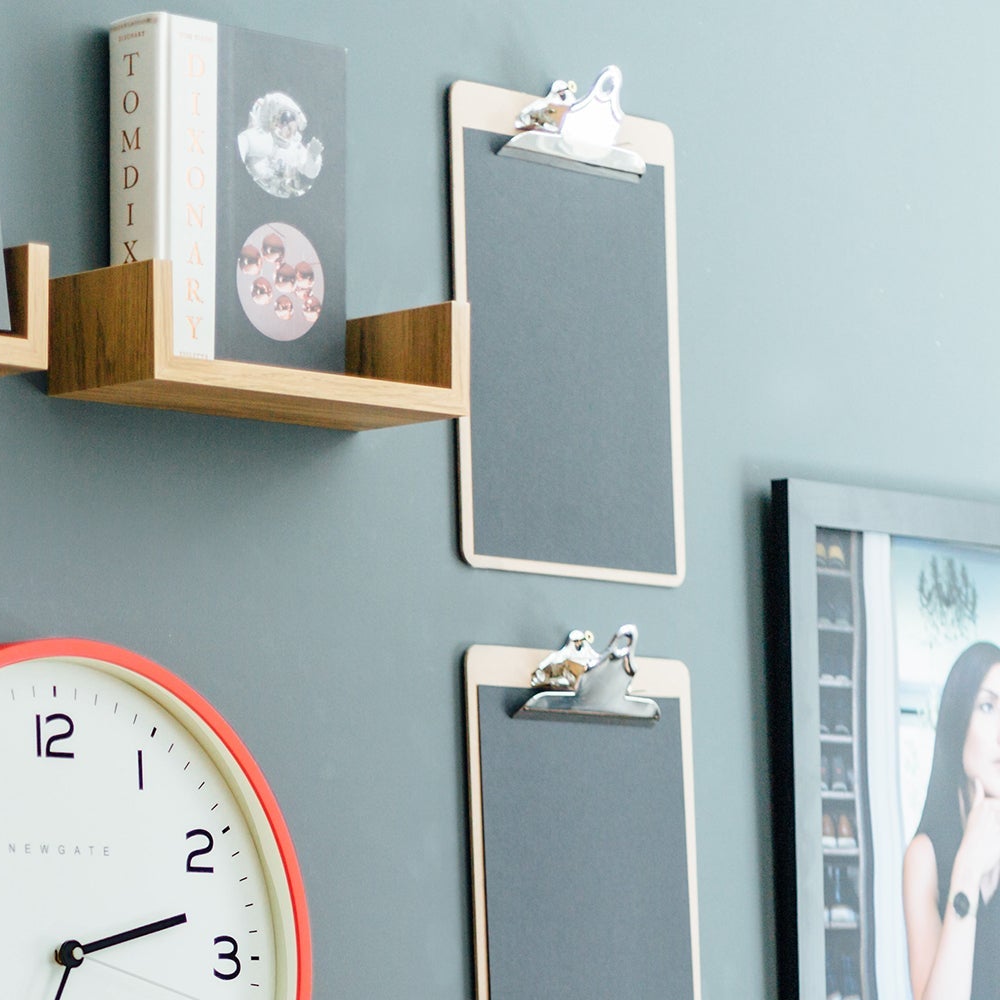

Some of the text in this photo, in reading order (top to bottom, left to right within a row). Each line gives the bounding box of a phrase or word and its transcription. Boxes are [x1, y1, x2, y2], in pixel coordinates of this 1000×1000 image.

[36, 714, 74, 758] 12
[138, 750, 143, 790] 1
[8, 843, 109, 857] NEWGATE
[186, 829, 214, 873] 2
[214, 936, 241, 980] 3
